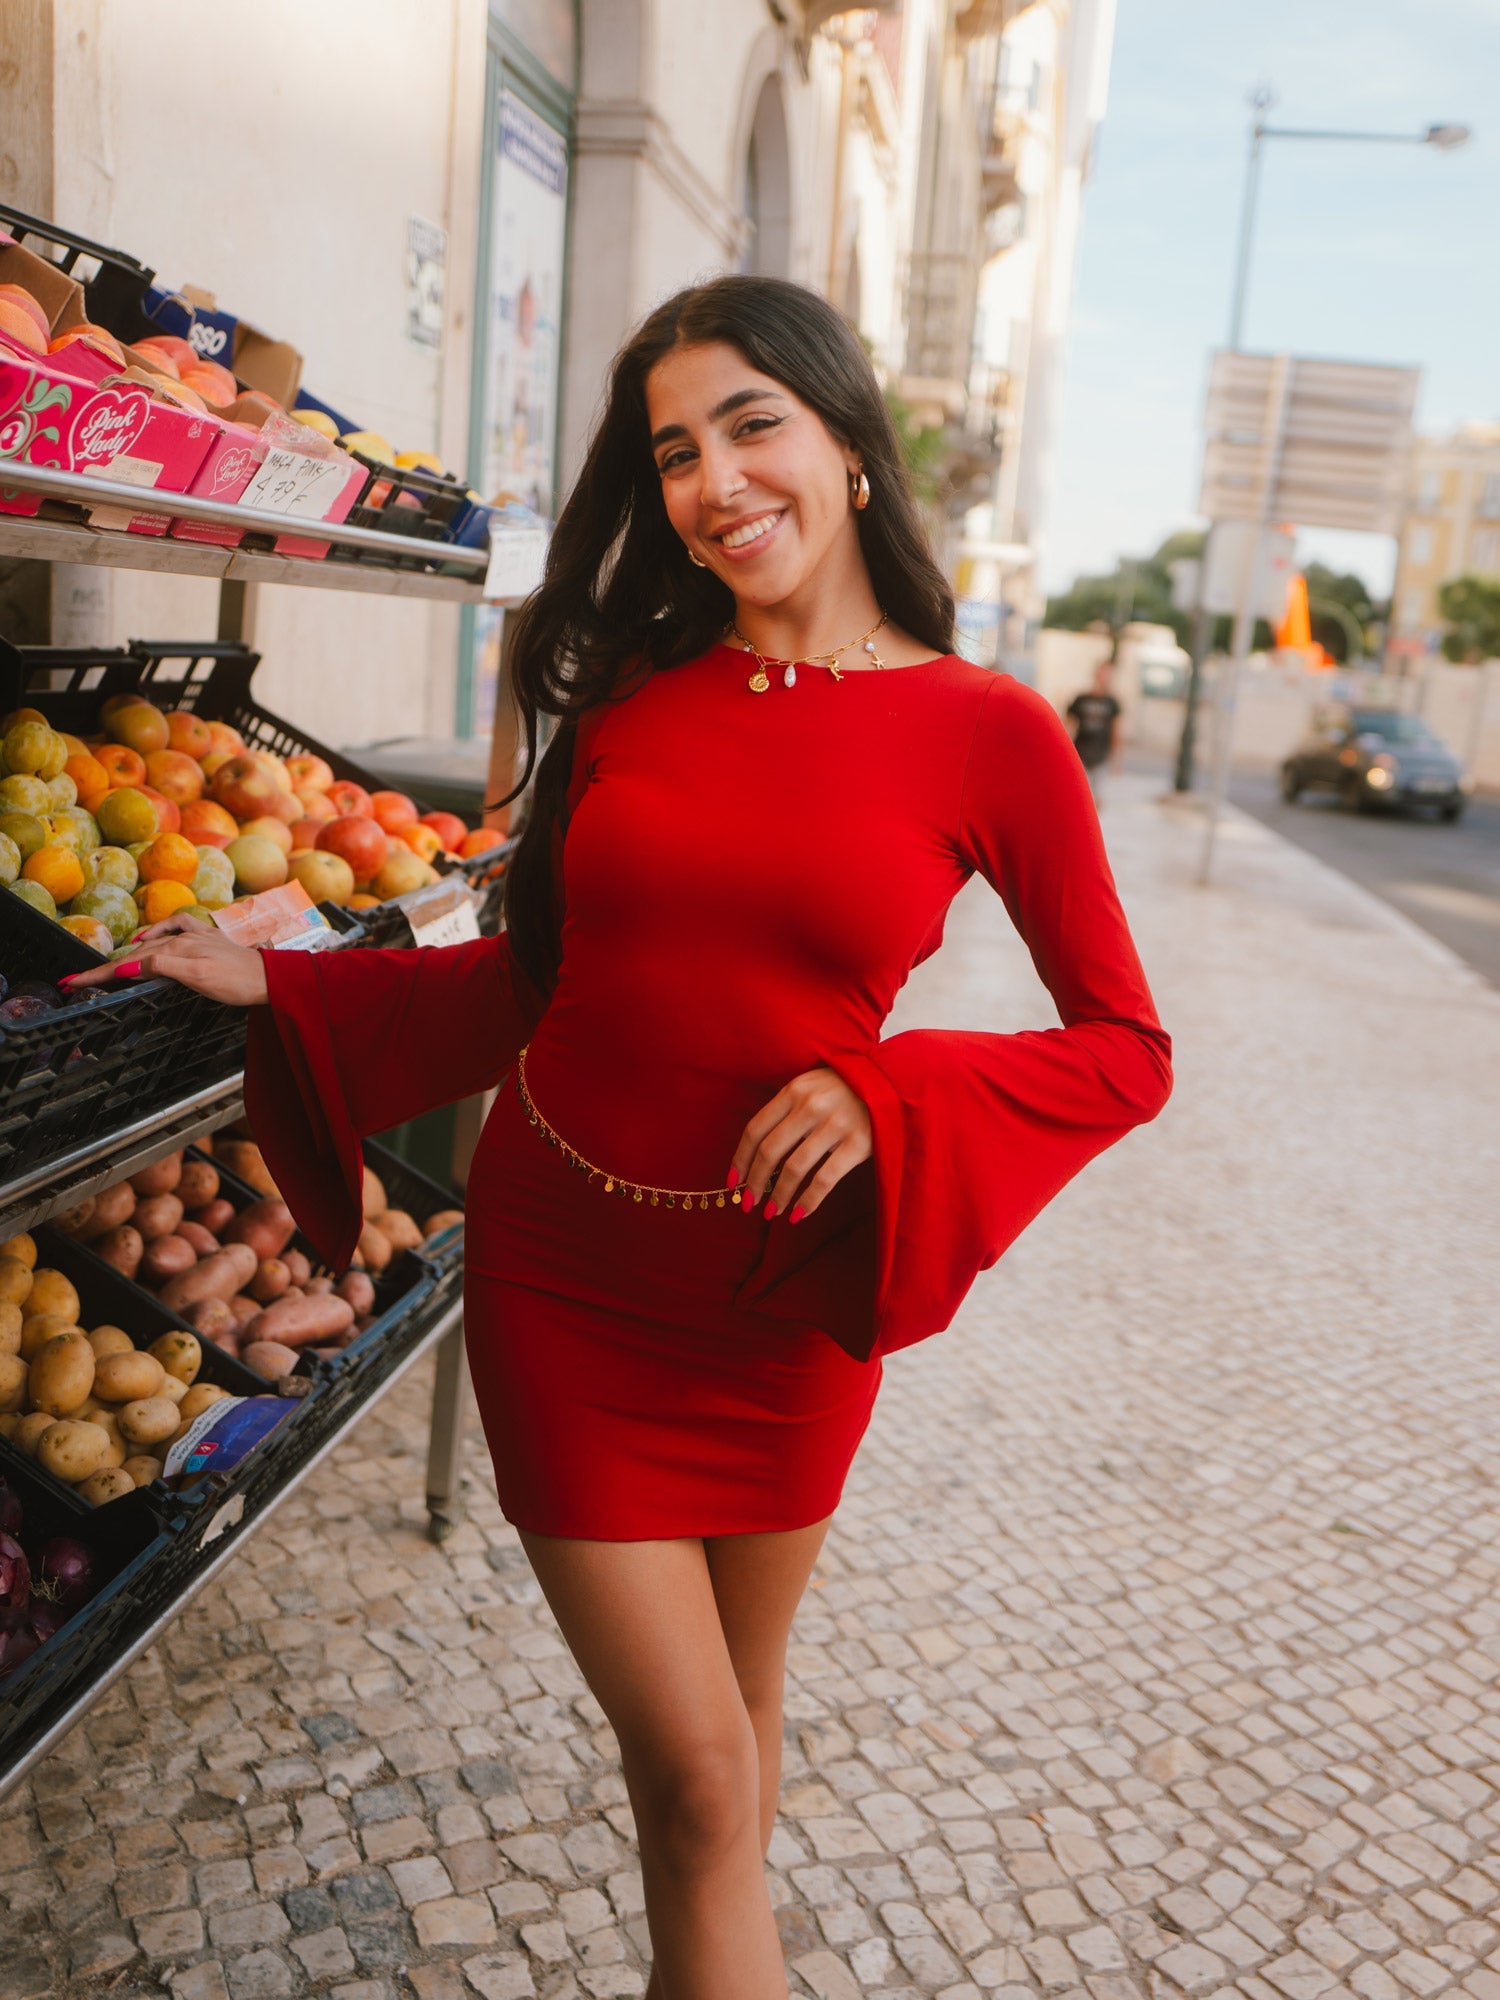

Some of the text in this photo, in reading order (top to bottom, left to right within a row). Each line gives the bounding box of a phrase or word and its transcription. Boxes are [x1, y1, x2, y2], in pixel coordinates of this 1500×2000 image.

[80, 402, 138, 438] Pink
[220, 454, 247, 471] Pink
[216, 466, 242, 482] Lady
